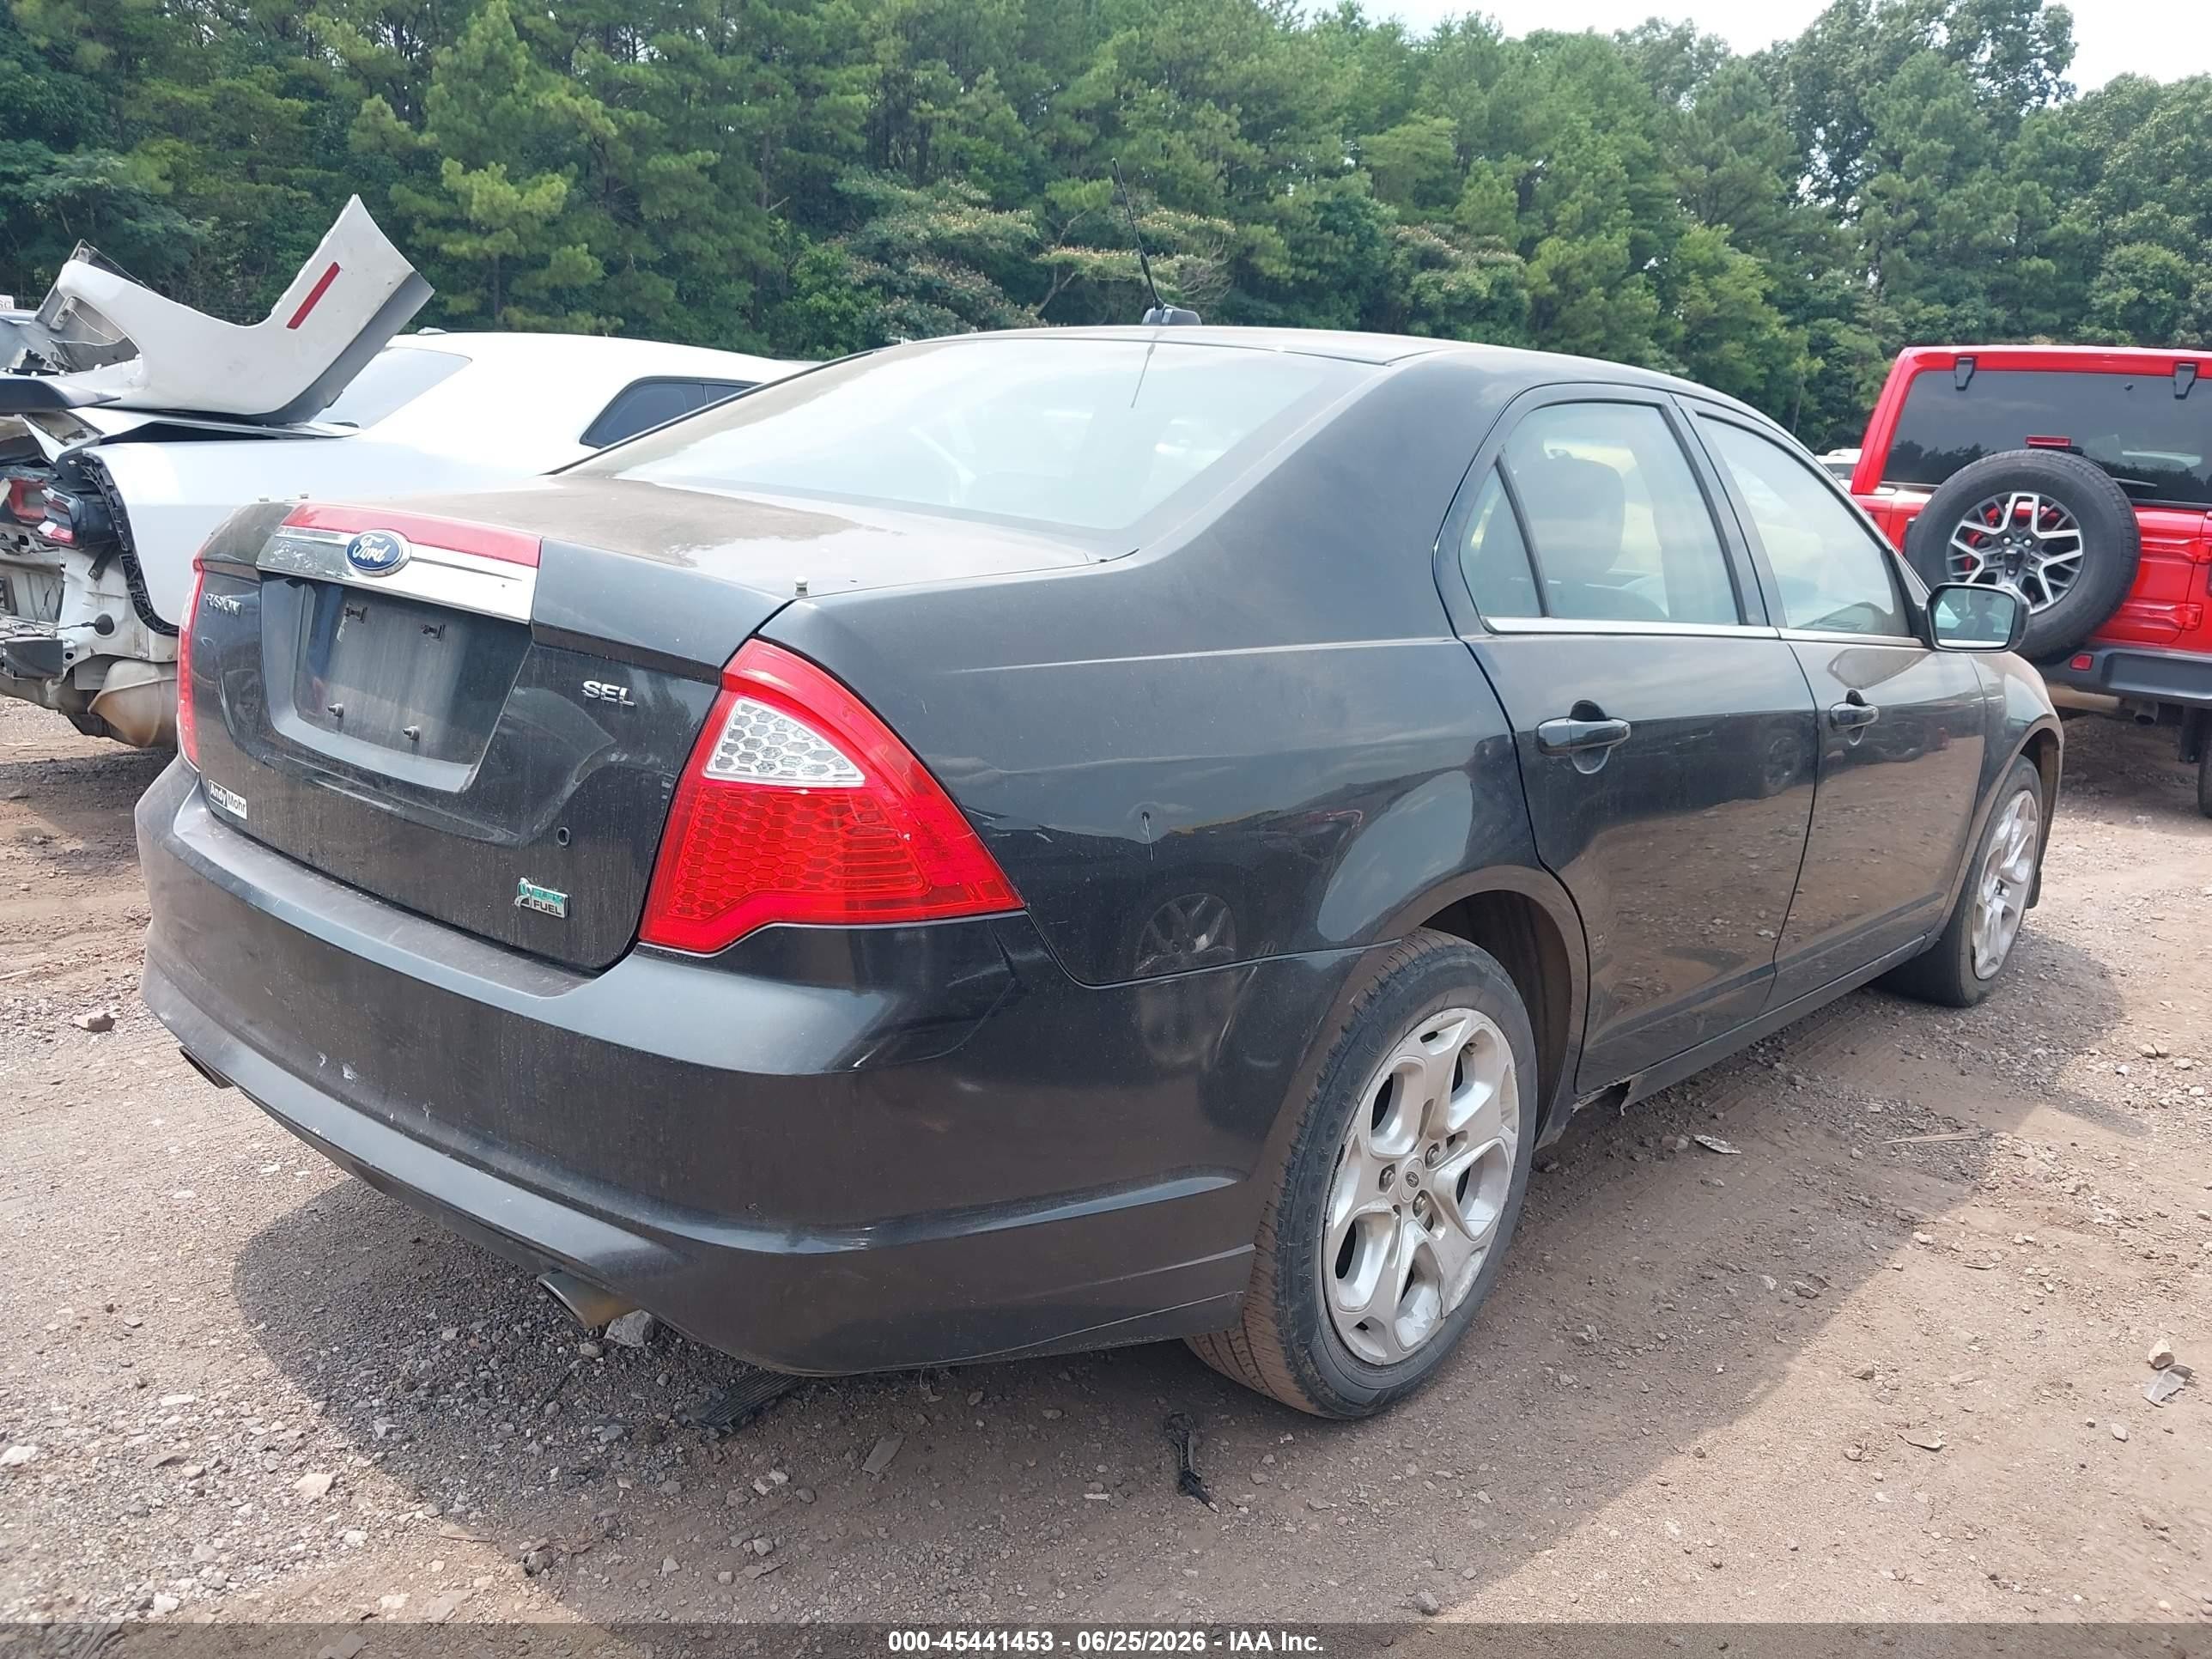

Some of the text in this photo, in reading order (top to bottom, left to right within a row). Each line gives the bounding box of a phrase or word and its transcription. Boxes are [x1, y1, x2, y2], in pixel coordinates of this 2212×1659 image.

[352, 534, 392, 563] Ford
[582, 680, 635, 707] SEL
[210, 782, 246, 814] Andy Mohr
[533, 899, 562, 915] FUEL
